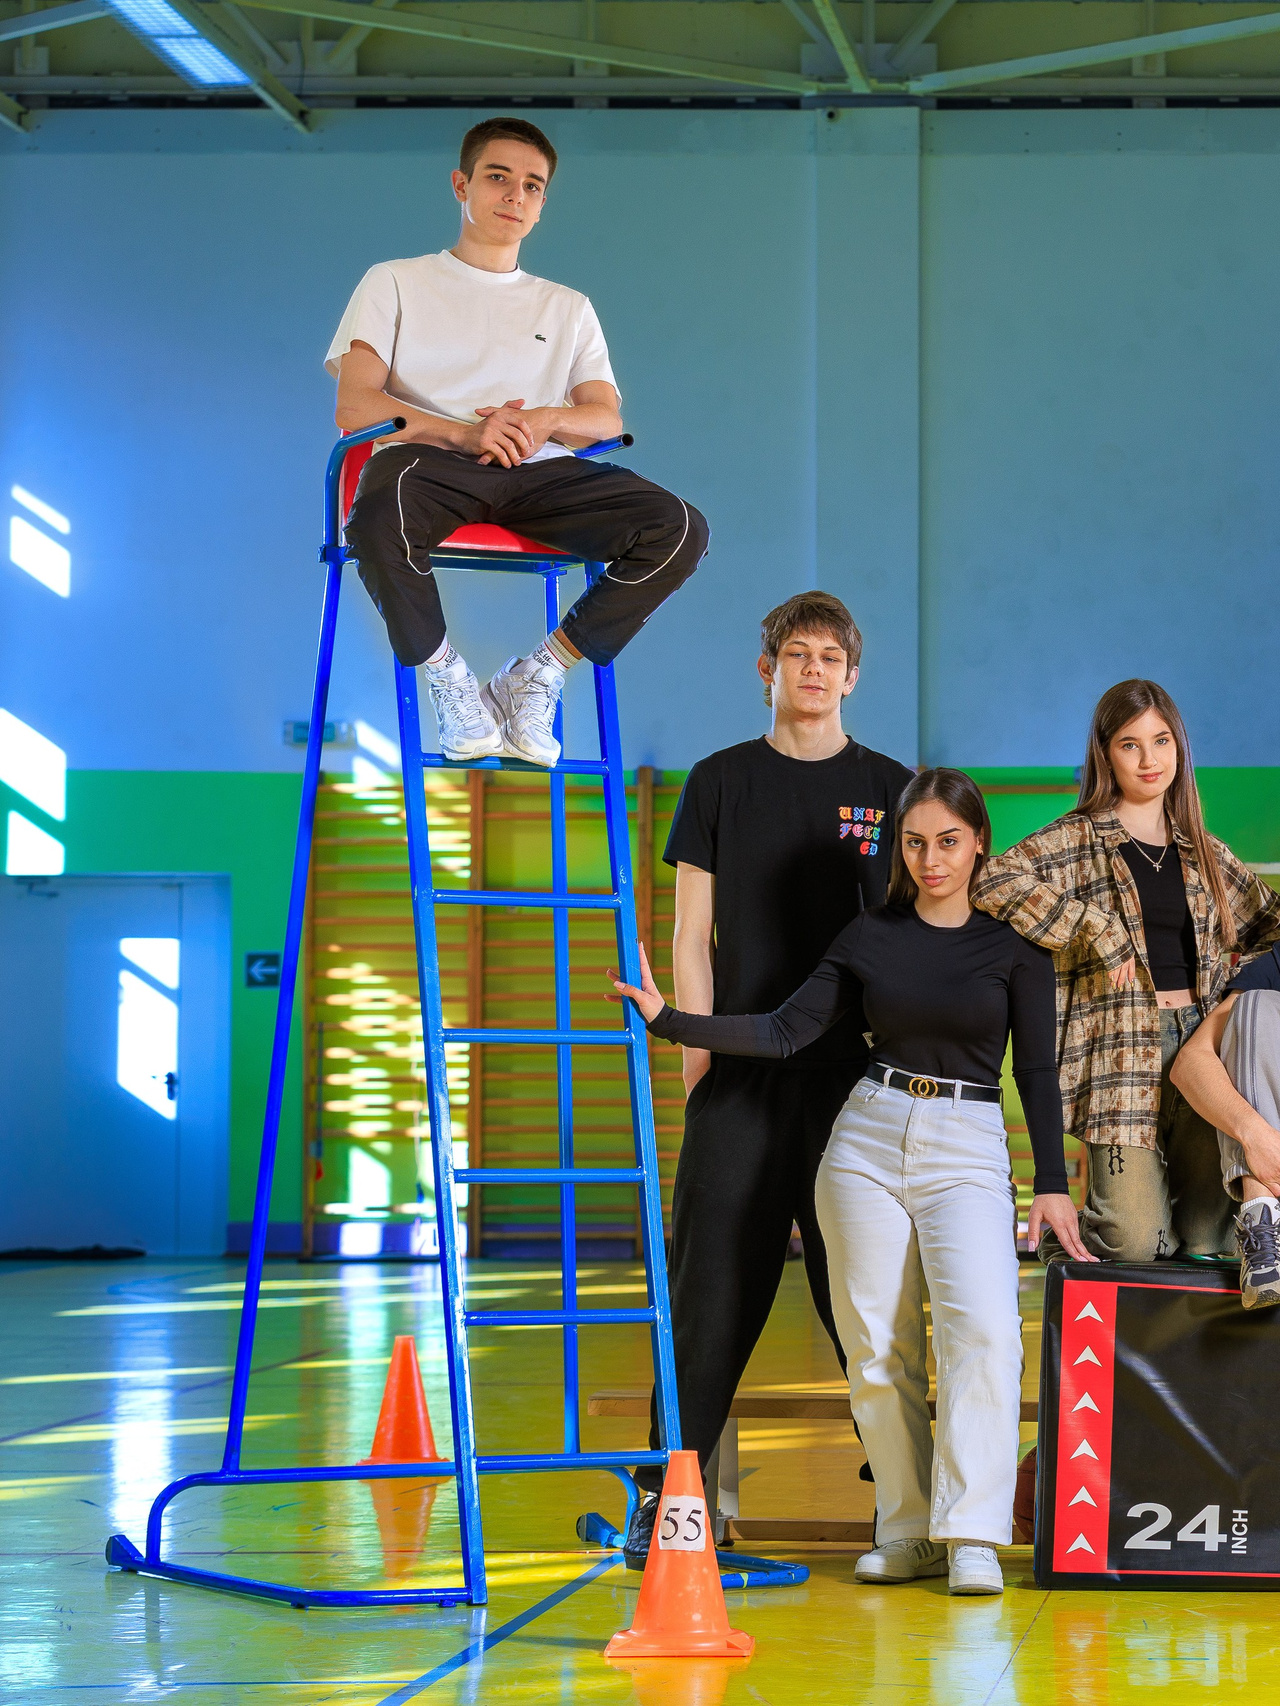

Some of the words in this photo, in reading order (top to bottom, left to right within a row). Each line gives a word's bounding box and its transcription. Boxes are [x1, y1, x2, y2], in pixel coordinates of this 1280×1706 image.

[661, 1507, 702, 1542] 55
[1124, 1502, 1228, 1552] 24
[1231, 1509, 1249, 1555] INCH
